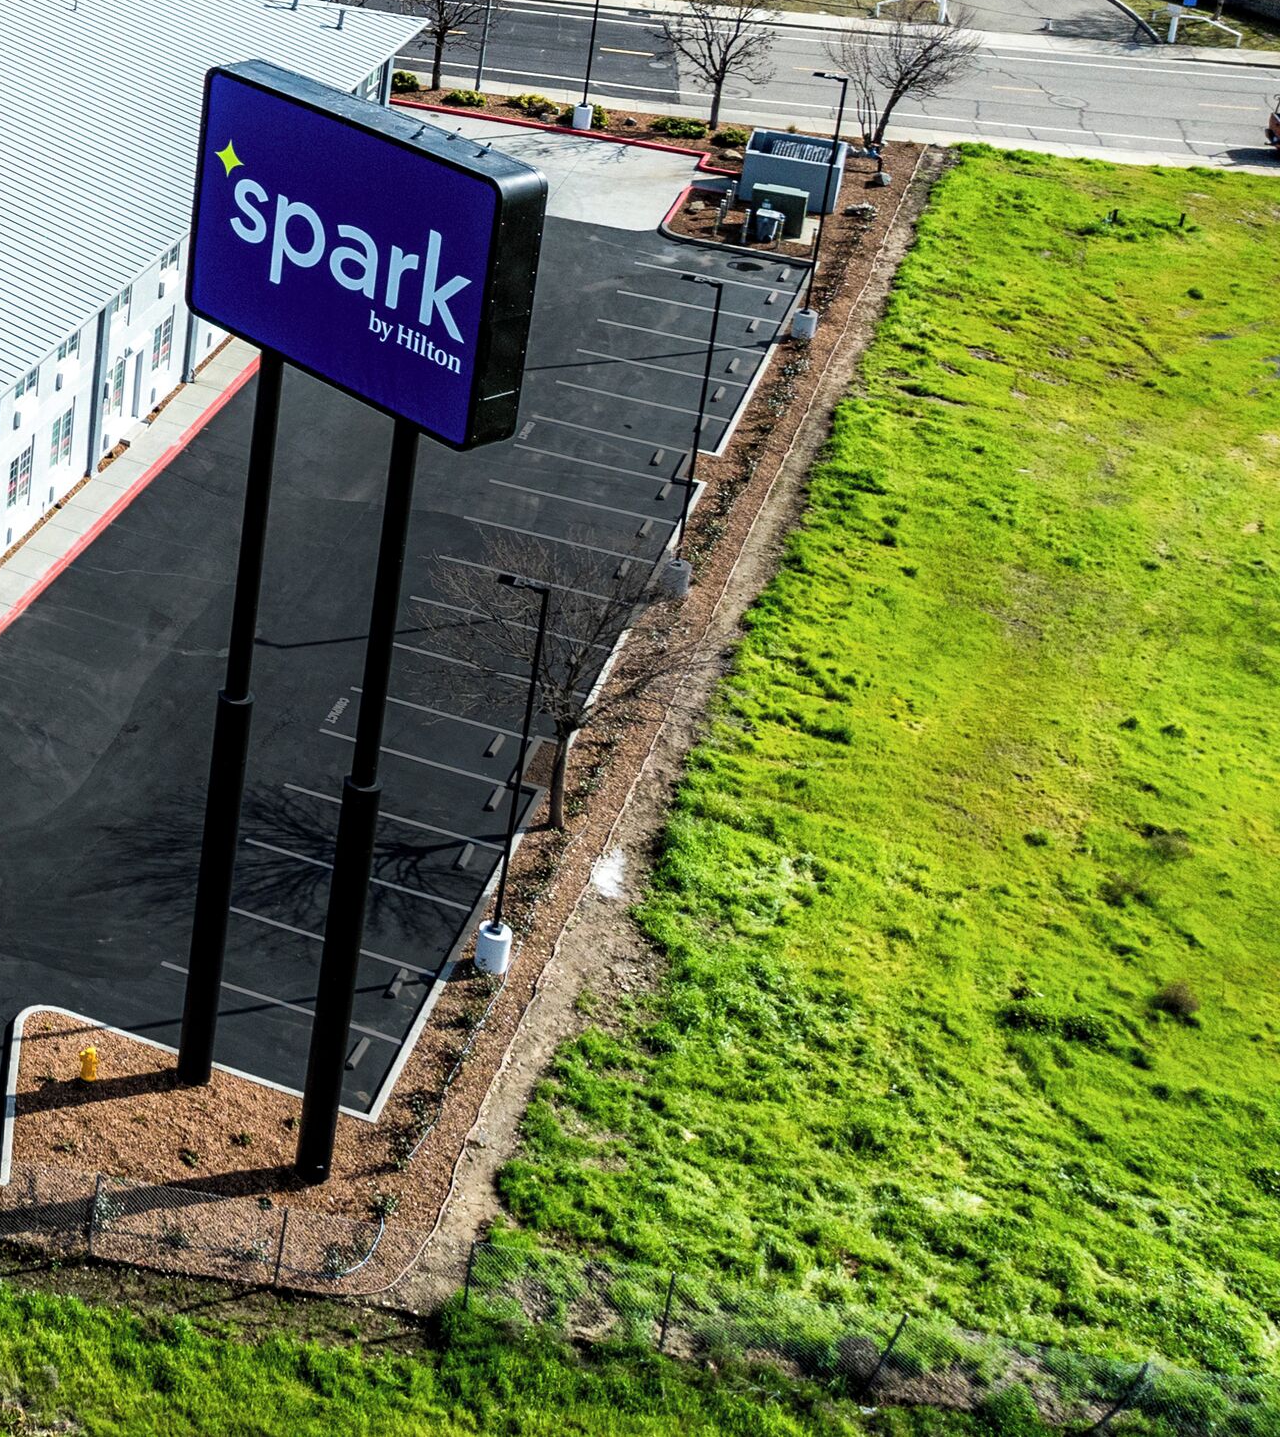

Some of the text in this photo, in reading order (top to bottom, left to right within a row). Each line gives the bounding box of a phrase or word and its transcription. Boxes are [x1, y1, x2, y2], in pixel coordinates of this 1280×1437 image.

[230, 178, 472, 344] spark
[368, 311, 462, 375] by Hilton
